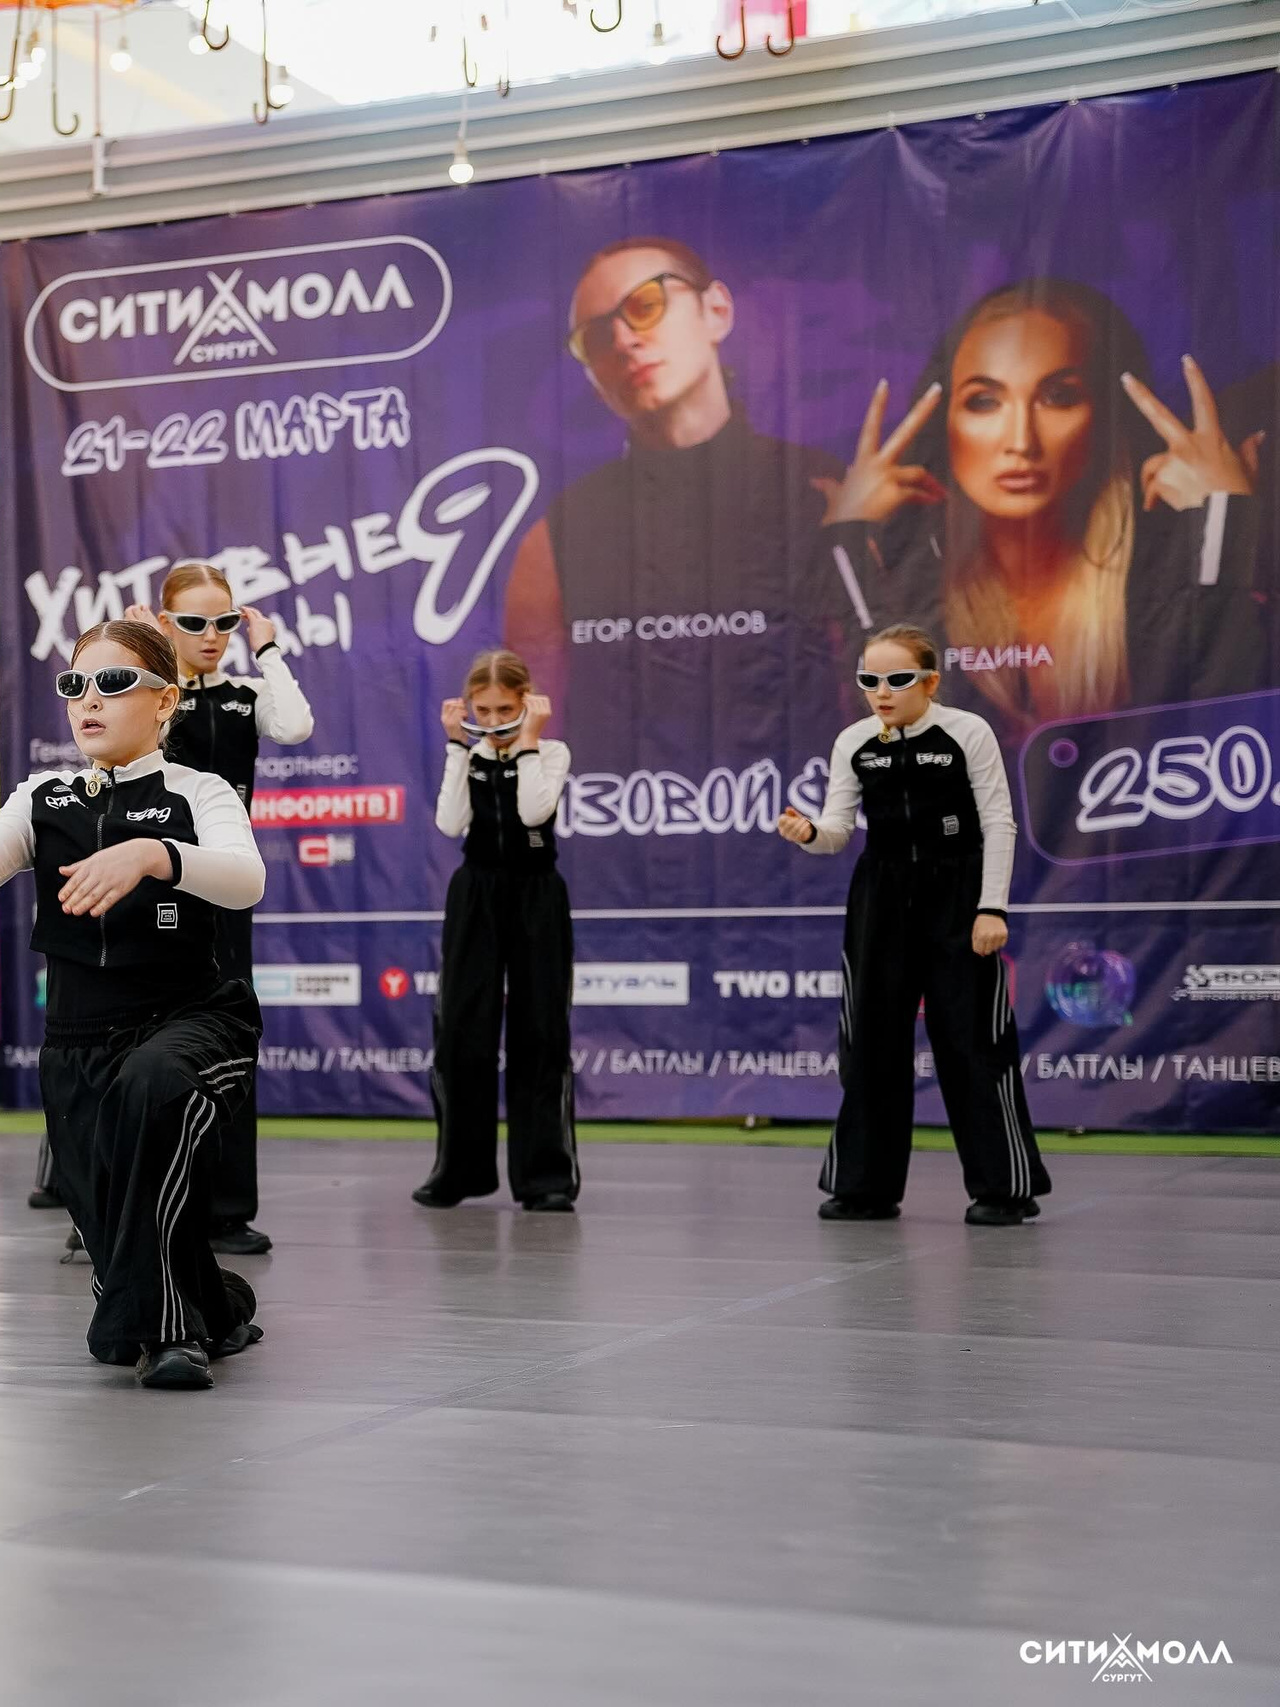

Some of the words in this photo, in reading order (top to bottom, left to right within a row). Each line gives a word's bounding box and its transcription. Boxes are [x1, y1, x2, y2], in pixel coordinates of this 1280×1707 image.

[59, 285, 204, 344] СИТИ
[246, 263, 415, 323] МОЛЛ
[189, 338, 261, 364] СУРГУТ
[61, 408, 230, 478] 21-22
[234, 385, 412, 461] МАРТА
[24, 511, 414, 662] ХИТВЫЕ
[572, 617, 633, 645] ЕГОР
[635, 609, 767, 642] СОКОЛОВ
[944, 643, 1055, 673] РЕДИНА
[254, 753, 360, 781] артнер:
[713, 970, 790, 999] TWO
